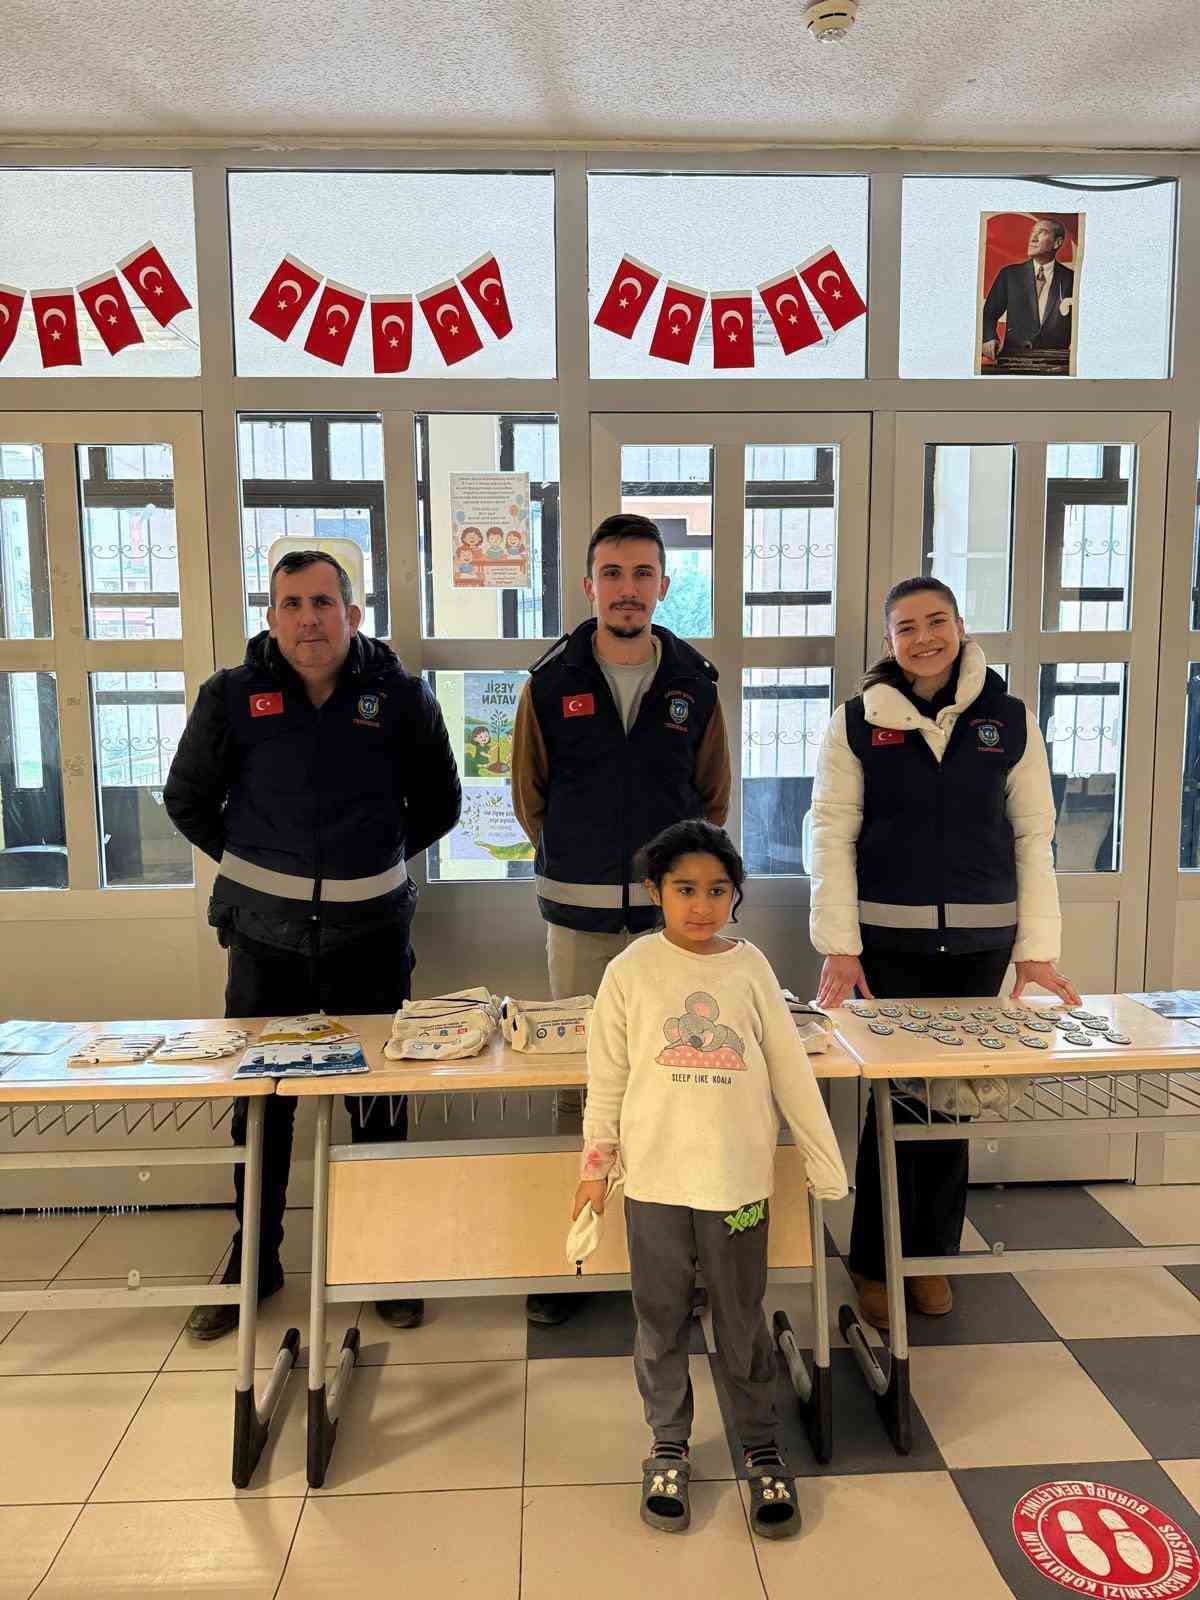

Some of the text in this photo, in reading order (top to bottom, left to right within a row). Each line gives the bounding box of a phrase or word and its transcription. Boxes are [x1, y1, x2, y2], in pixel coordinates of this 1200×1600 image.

[672, 1073, 732, 1085] SLEEP LIKE KOALA
[1086, 1482, 1149, 1515] BURADA
[1021, 1531, 1097, 1593] KORUYALIM
[1158, 1524, 1193, 1570] SOSYAL
